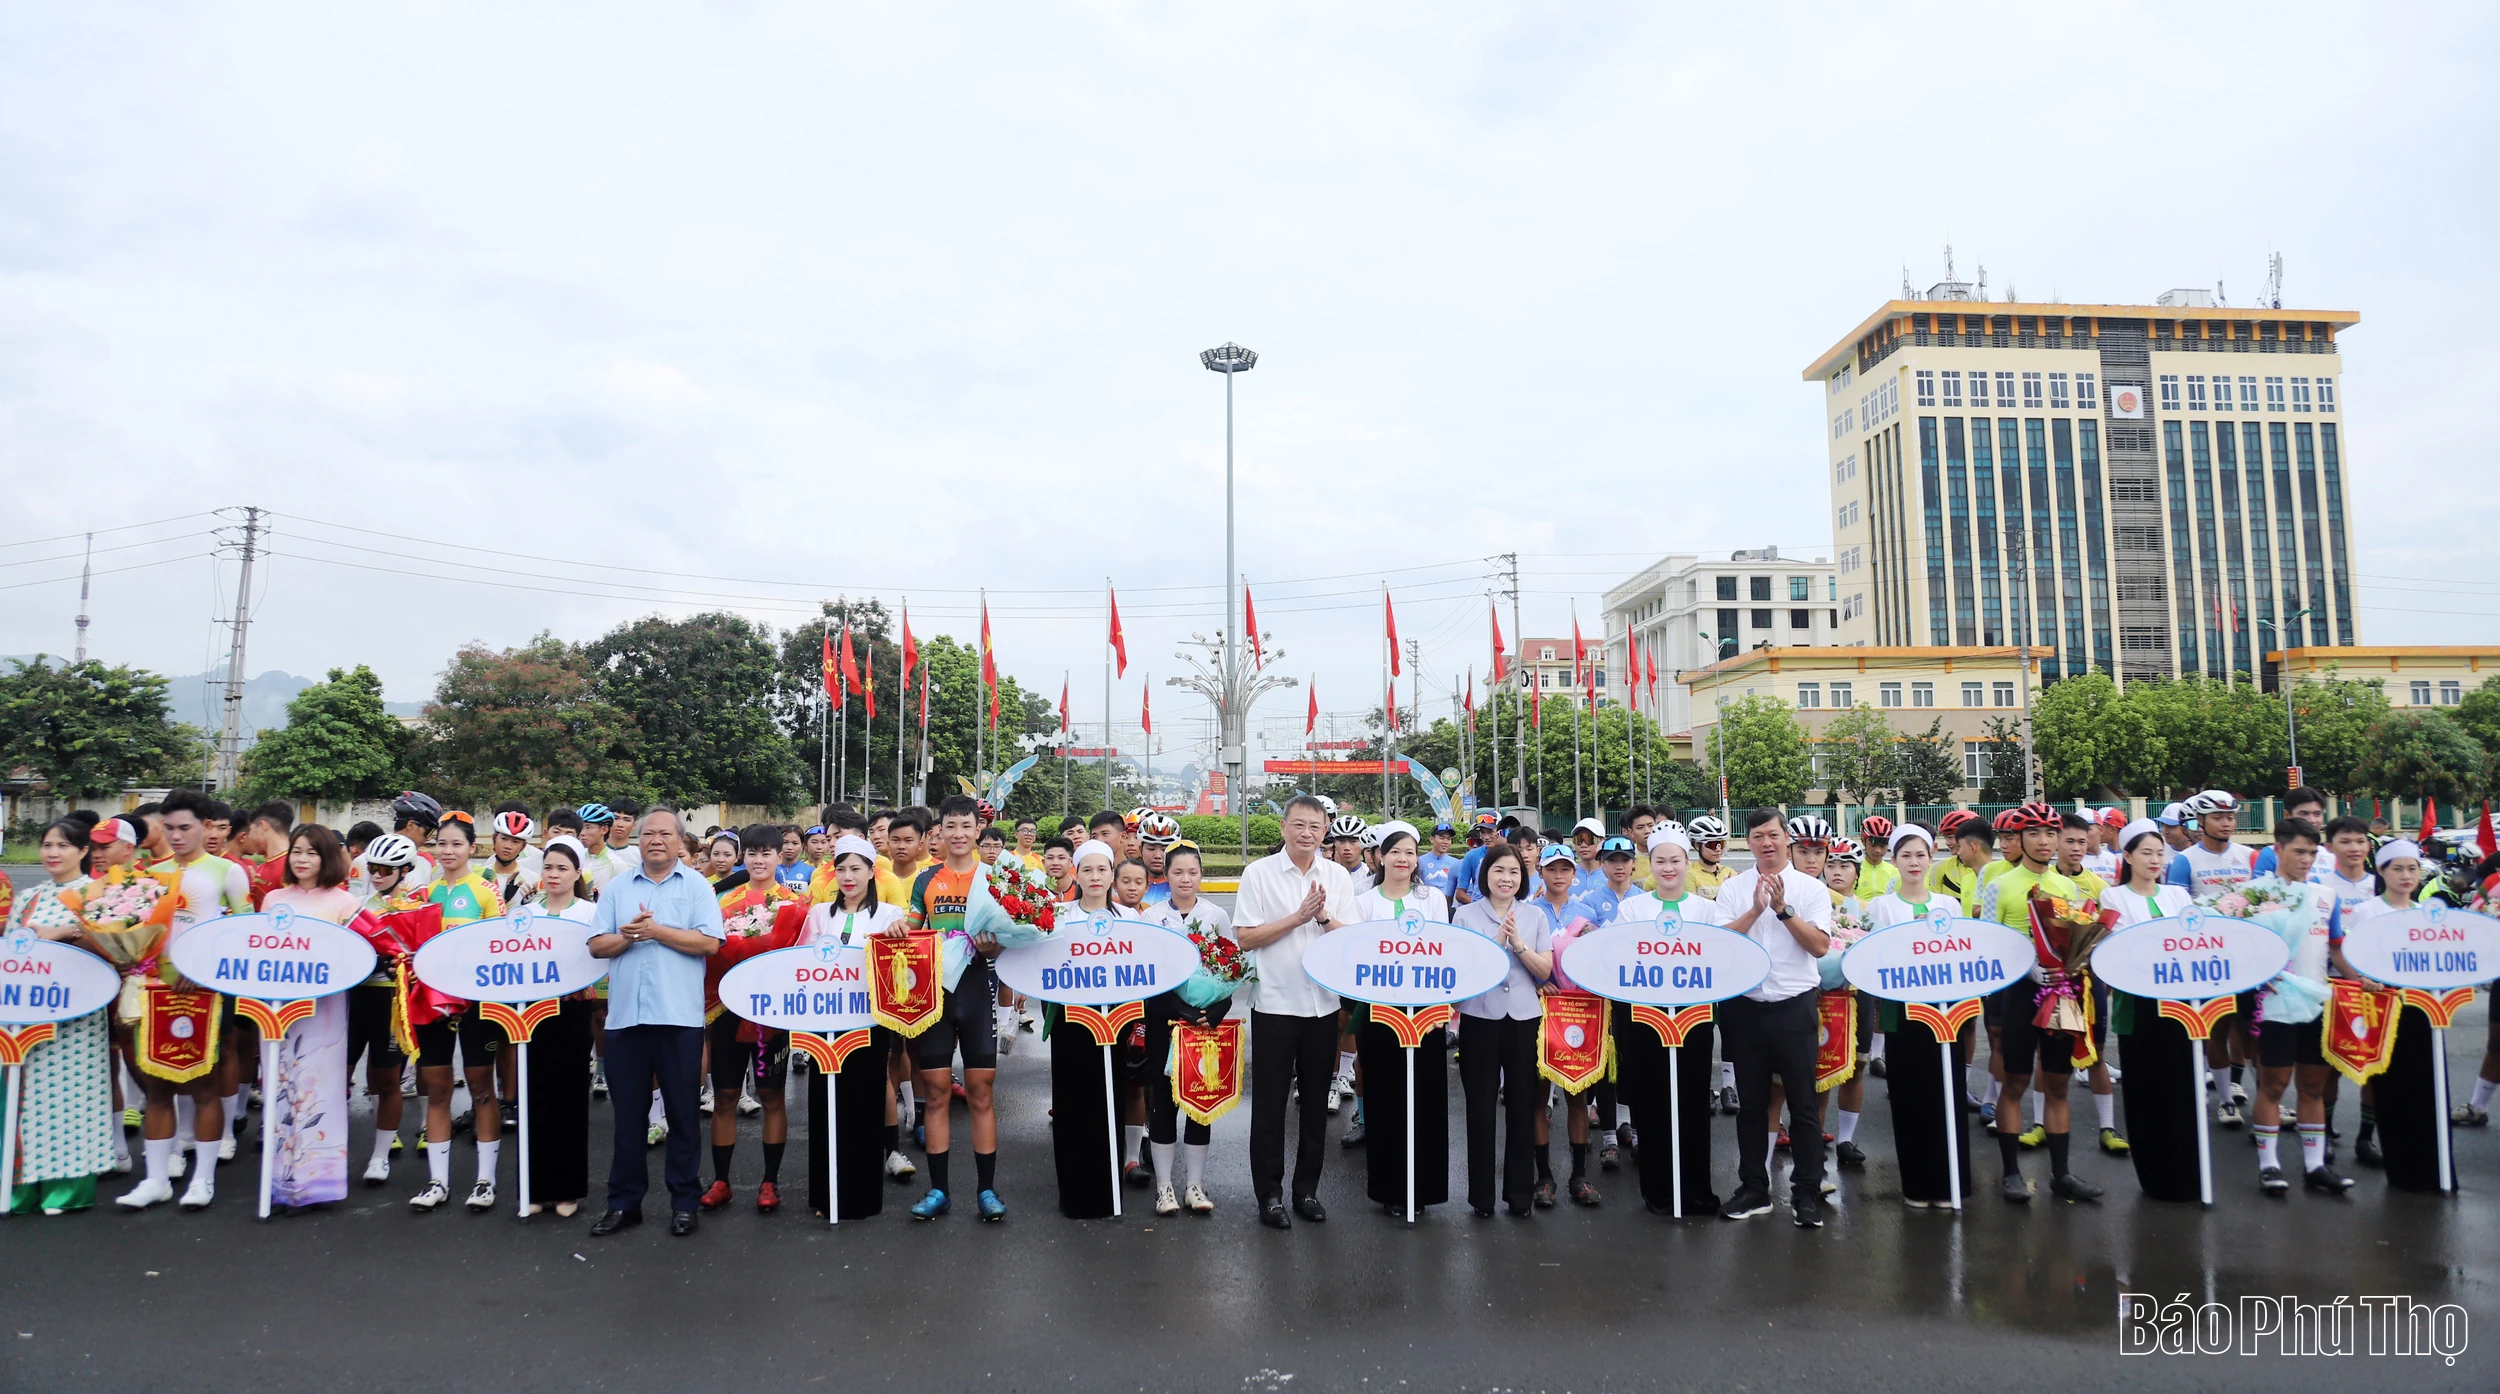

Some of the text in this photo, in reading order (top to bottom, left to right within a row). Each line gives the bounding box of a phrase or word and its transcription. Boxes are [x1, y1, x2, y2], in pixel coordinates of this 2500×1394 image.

[480, 880, 507, 917] BIWAS
[933, 895, 967, 904] MAXX
[935, 905, 946, 914] LE
[248, 932, 311, 950] ĐOÀN
[489, 933, 552, 954] ĐOÀN
[2163, 932, 2224, 952] ĐOÀN
[2408, 924, 2465, 942] ĐOÀN
[1069, 937, 1133, 957] ĐOÀN
[1378, 937, 1443, 956] ĐOÀN
[1637, 937, 1702, 956] ĐOÀN
[1912, 934, 1972, 955] ĐOÀN
[0, 956, 51, 975] OÀN
[2393, 947, 2477, 972] VĨNH LONG
[216, 958, 329, 984] AN GIANG
[475, 960, 561, 987] SƠN LA
[795, 963, 860, 982] ĐOÀN
[1042, 960, 1156, 990] ĐỒNG NAI
[1356, 960, 1456, 994] PHÚ THỌ
[1619, 961, 1712, 989] LÀO CAI
[1877, 956, 2005, 990] THANH HÓA
[2153, 955, 2230, 986] HÀ NỘI
[30, 981, 70, 1013] ĐỘI
[750, 986, 872, 1016] TP. HỒ CHÍ MI
